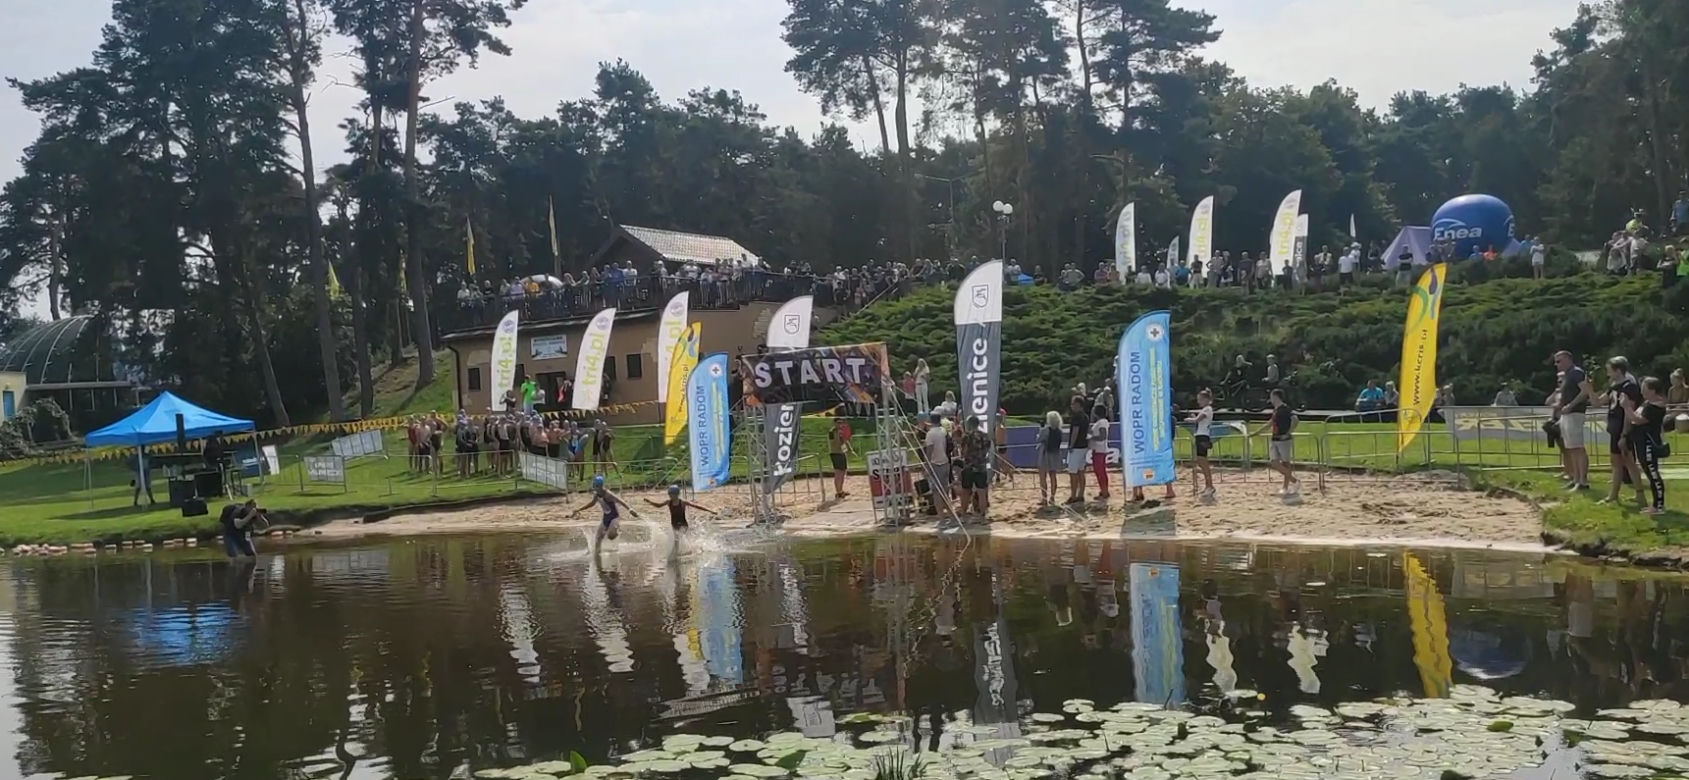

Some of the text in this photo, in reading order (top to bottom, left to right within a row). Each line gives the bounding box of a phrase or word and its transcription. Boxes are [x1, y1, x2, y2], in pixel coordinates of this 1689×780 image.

[1433, 227, 1482, 240] Enea
[496, 336, 513, 389] tri4.pl
[581, 332, 605, 385] tri4.pl
[754, 357, 867, 388] START
[696, 385, 710, 466] WOPR RADOM
[1130, 351, 1145, 454] WOPR RADOM
